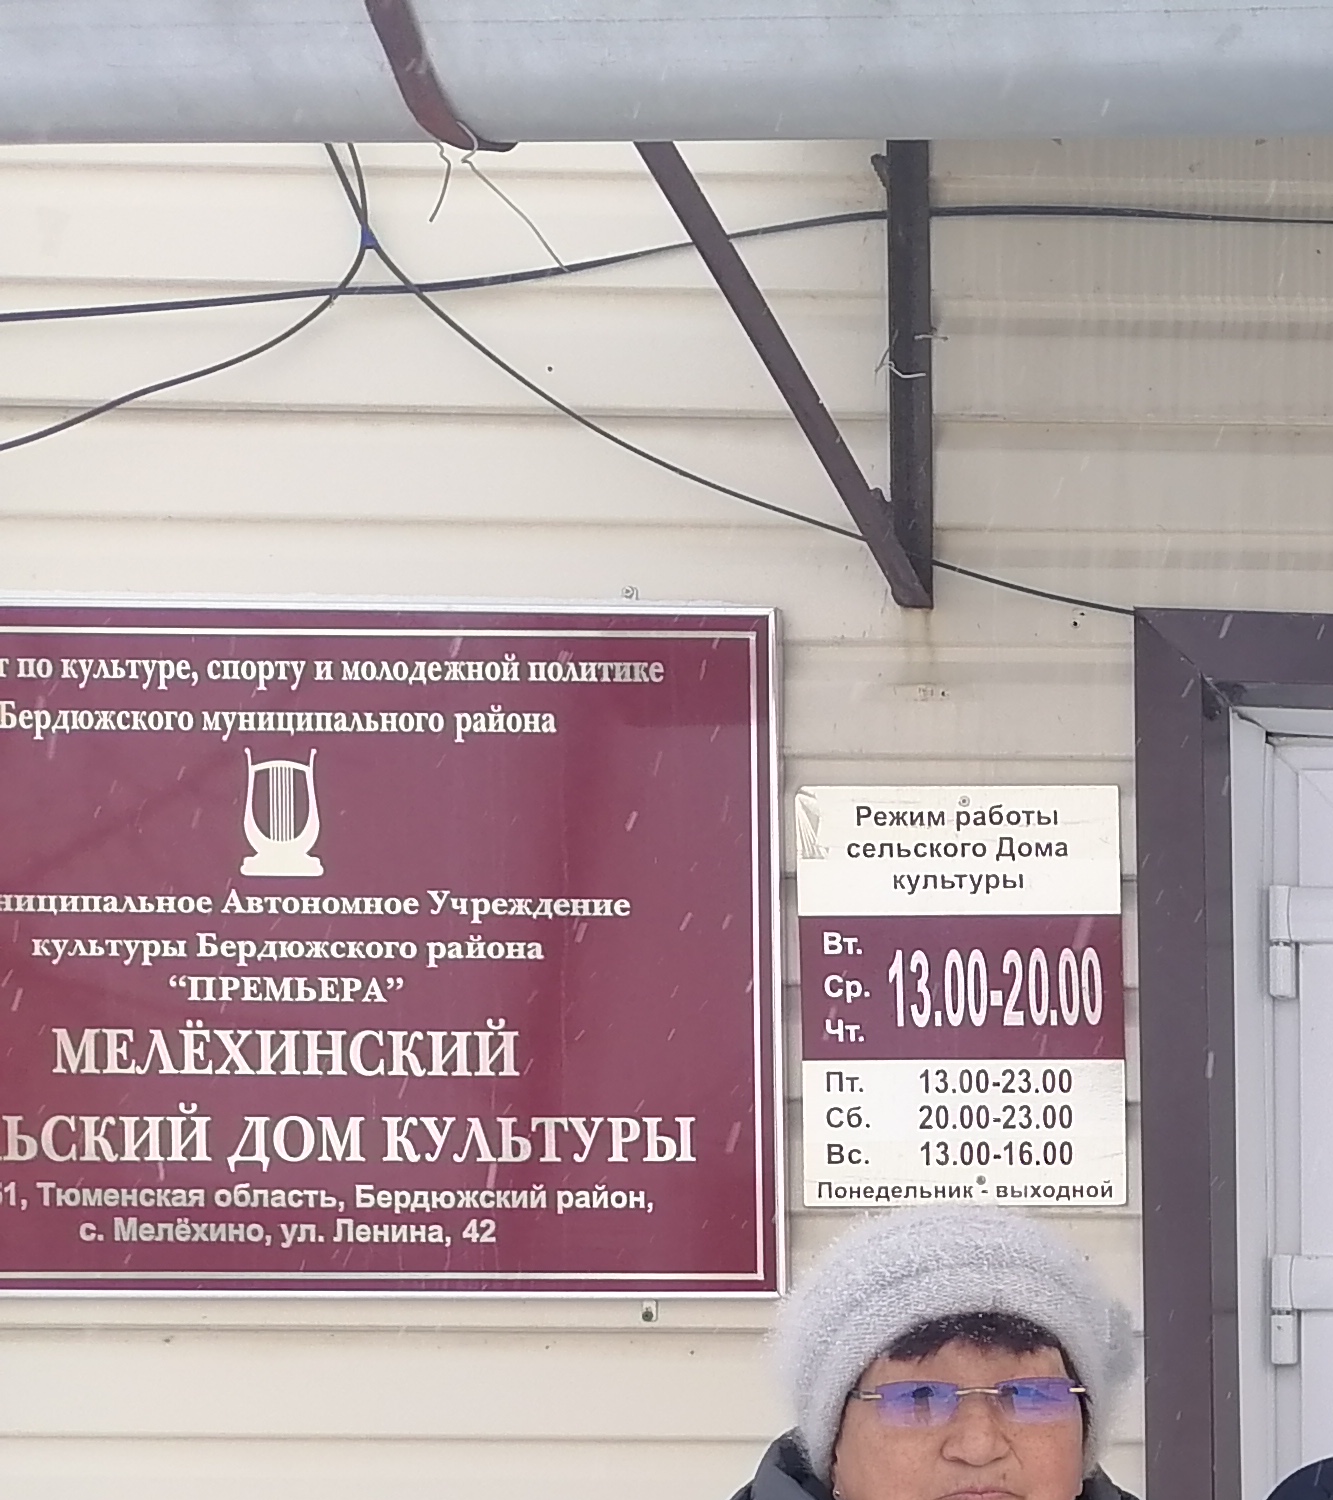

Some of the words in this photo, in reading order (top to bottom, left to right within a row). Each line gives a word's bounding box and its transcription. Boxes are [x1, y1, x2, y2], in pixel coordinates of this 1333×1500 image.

[17, 658, 53, 679] по
[60, 659, 199, 690] культуре,
[207, 658, 305, 690] спорту
[314, 661, 334, 682] и
[342, 654, 520, 683] молодежной
[528, 659, 664, 684] политике
[0, 700, 194, 739] Бердюжского
[202, 709, 444, 739] муниципального
[455, 706, 556, 741] района
[855, 806, 945, 826] Режим
[955, 806, 1058, 830] работы
[847, 839, 987, 858] сельского
[996, 837, 1068, 861] Дома
[893, 873, 1024, 894] культуры
[221, 890, 419, 916] Автономное
[428, 891, 630, 924] Учреждение
[32, 938, 187, 966] культуры
[197, 934, 417, 963] Бердюжского
[426, 933, 543, 966] района
[823, 932, 863, 955] Вт.
[824, 976, 870, 1000] Ср.
[888, 947, 1101, 1027] 13.00-20.00
[826, 1019, 864, 1042] Чт.
[52, 1018, 520, 1077] МЕЛЁХИНСКИЙ
[825, 1072, 864, 1093] Пт.
[919, 1069, 1072, 1093] 13.00-23.00
[826, 1107, 871, 1129] Сб.
[919, 1105, 1072, 1129] 20.00-23.00
[0, 1102, 212, 1162] ЬСКИЙ
[227, 1115, 365, 1173] ДОМ
[382, 1116, 697, 1163] КУЛЬТУРЫ
[827, 1144, 870, 1165] Вс.
[920, 1142, 1073, 1166] 13.00-16.00
[0, 1181, 27, 1211] 1,
[36, 1182, 205, 1207] Тюменская
[214, 1182, 345, 1212] область,
[355, 1182, 547, 1215] Бердюжский
[556, 1183, 654, 1215] район,
[818, 1182, 973, 1201] Понедельник
[996, 1181, 1113, 1201] выходной
[79, 1222, 104, 1241] с.
[113, 1217, 273, 1246] Мелёхино,
[280, 1222, 326, 1247] ул.
[333, 1219, 452, 1247] Ленина,
[463, 1220, 496, 1244] 42
